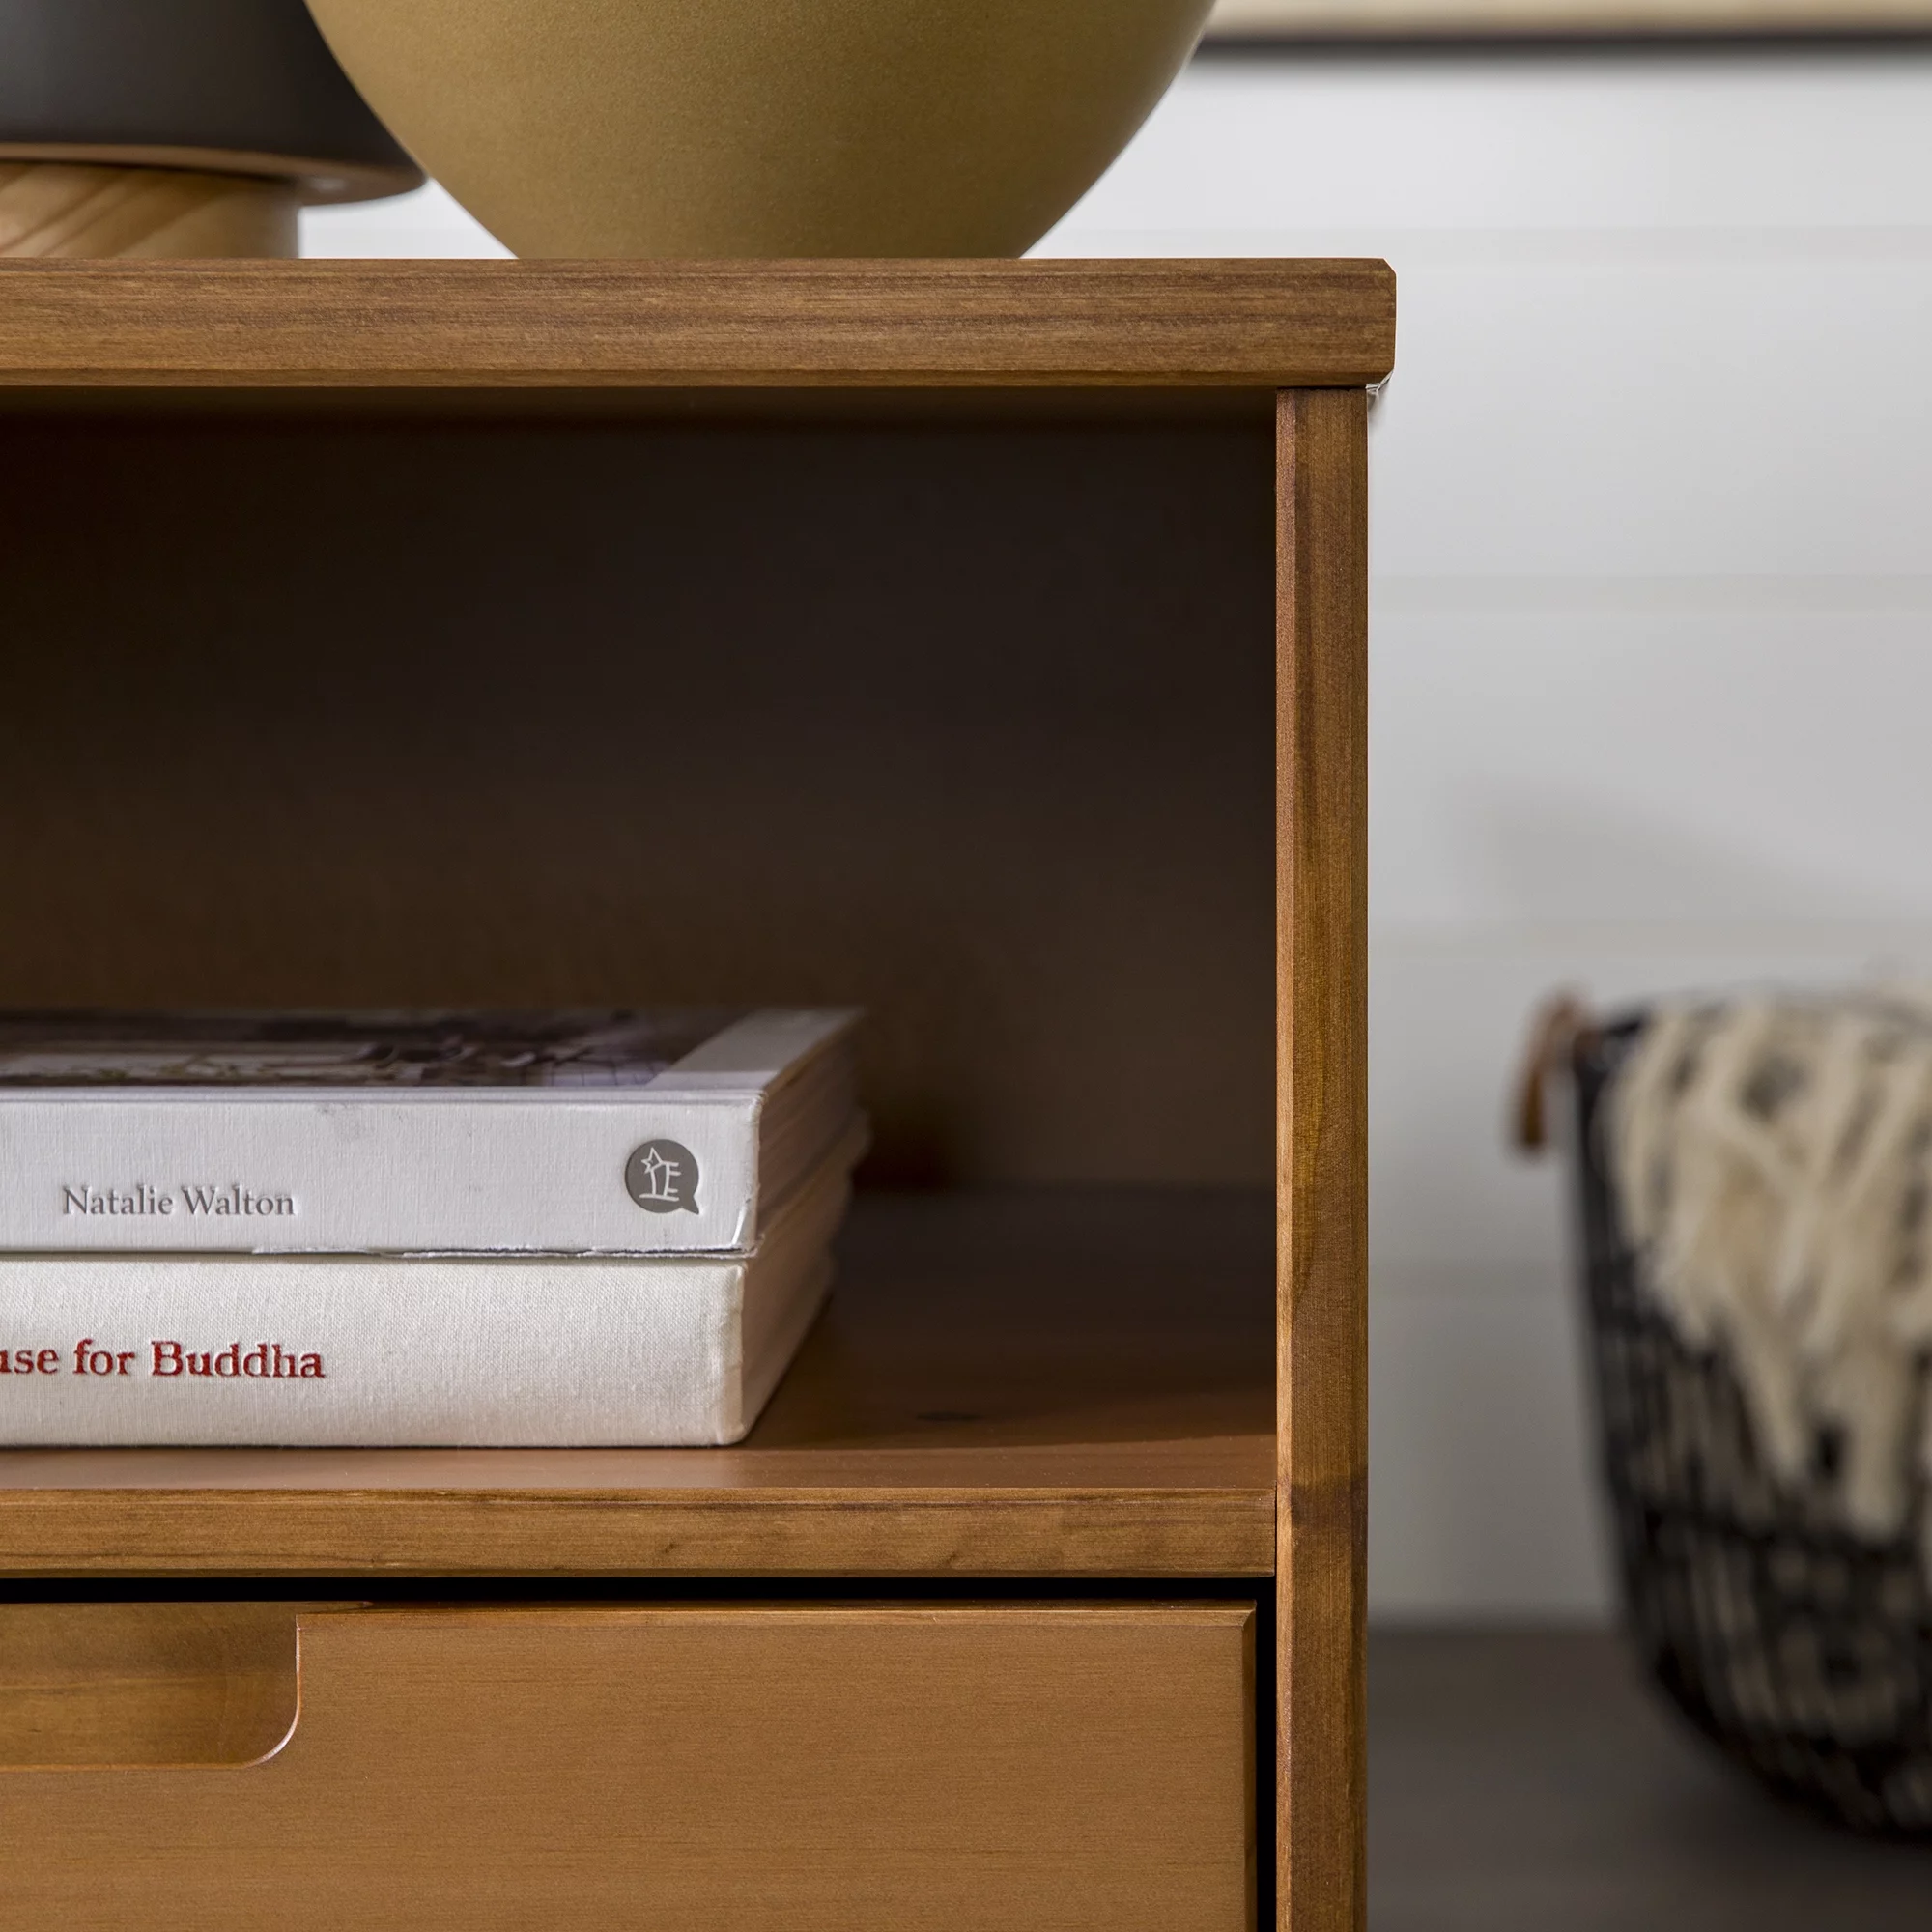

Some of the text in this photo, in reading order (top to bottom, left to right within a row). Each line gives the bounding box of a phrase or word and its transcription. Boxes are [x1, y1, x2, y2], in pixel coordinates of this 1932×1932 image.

[62, 1183, 296, 1215] Natalie Walton
[72, 1338, 135, 1376] for
[151, 1341, 326, 1378] Buddha
